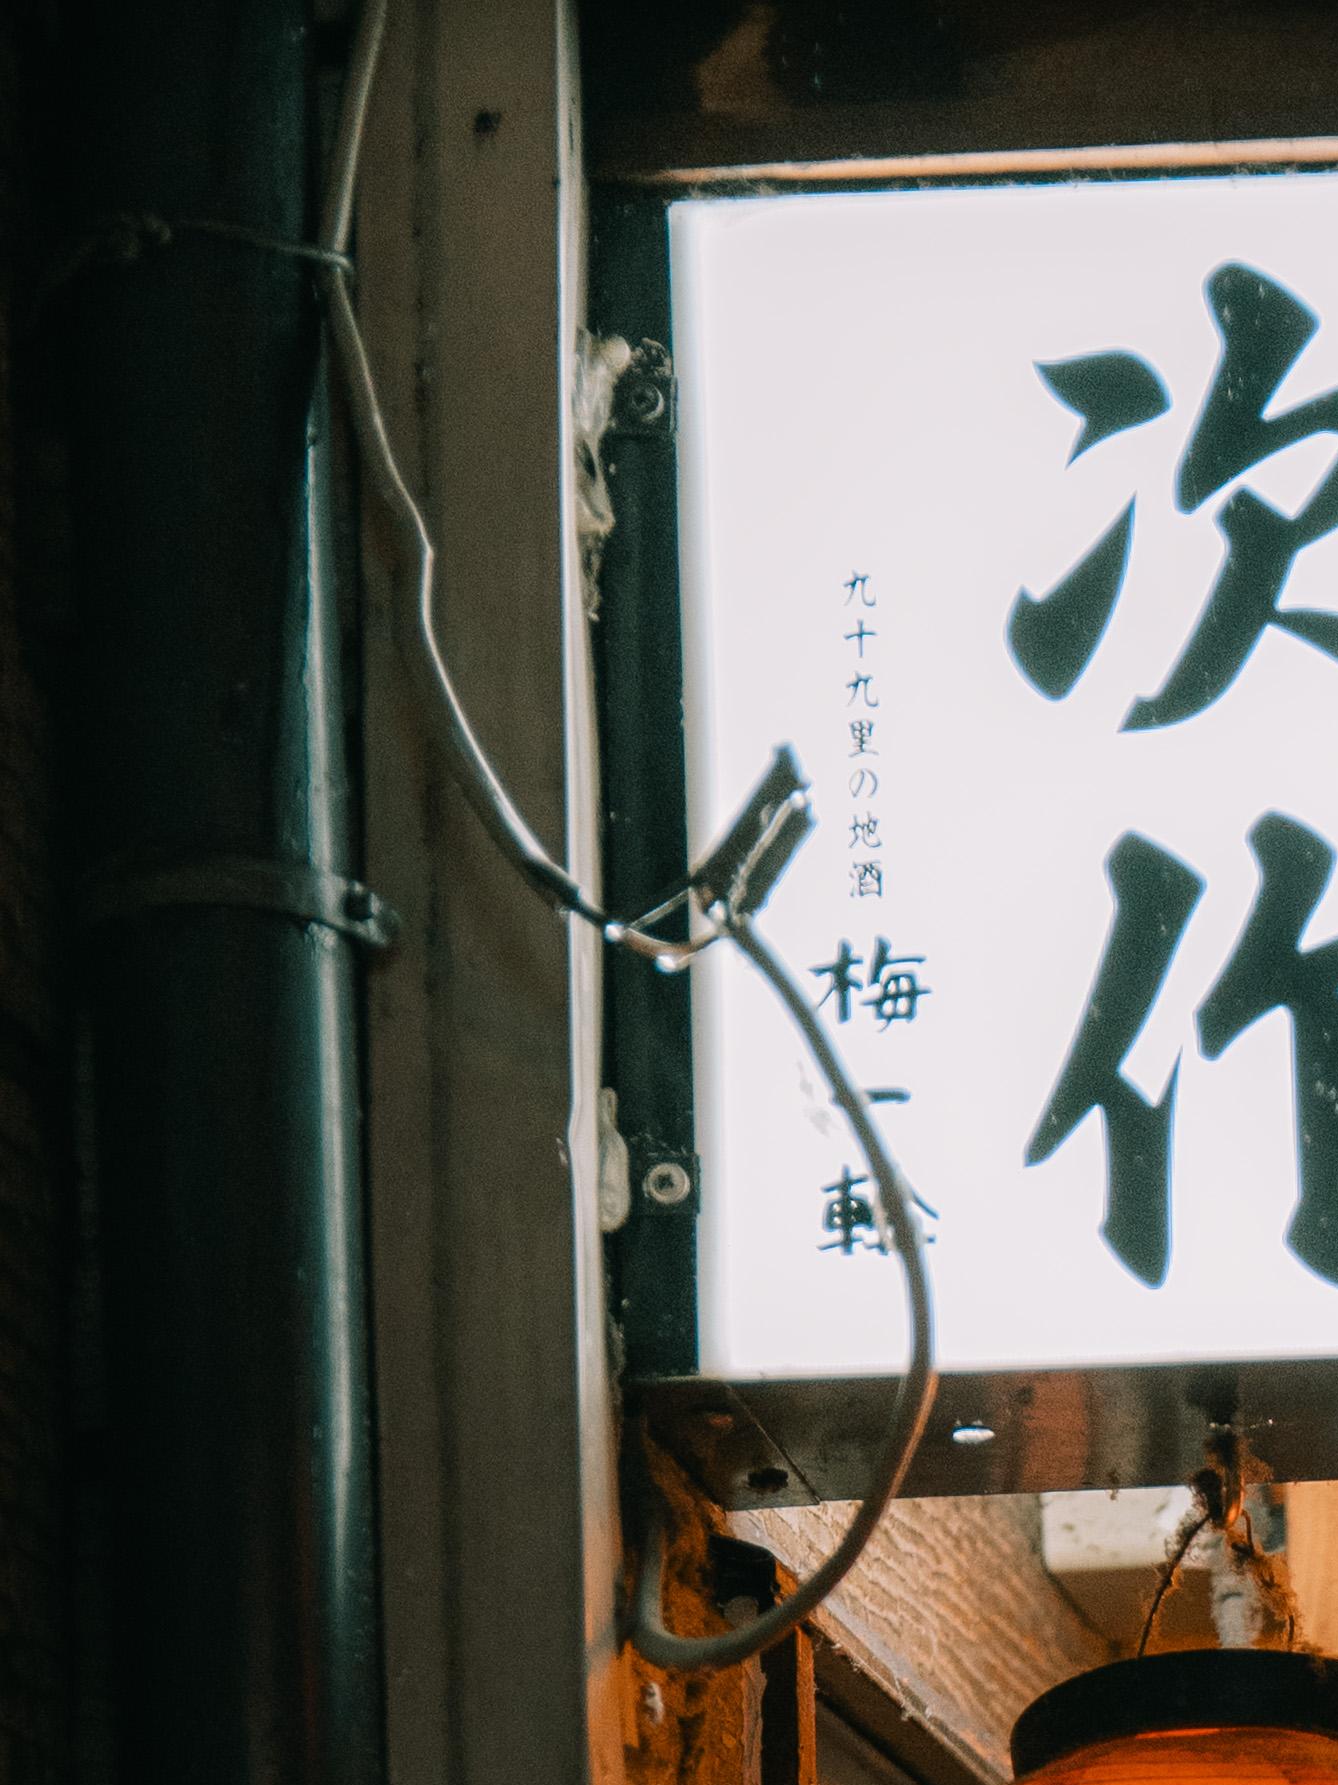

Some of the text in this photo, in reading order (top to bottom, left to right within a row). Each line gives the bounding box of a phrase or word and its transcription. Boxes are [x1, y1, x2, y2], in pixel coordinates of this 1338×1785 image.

[842, 570, 884, 900] 九十九里の地酒
